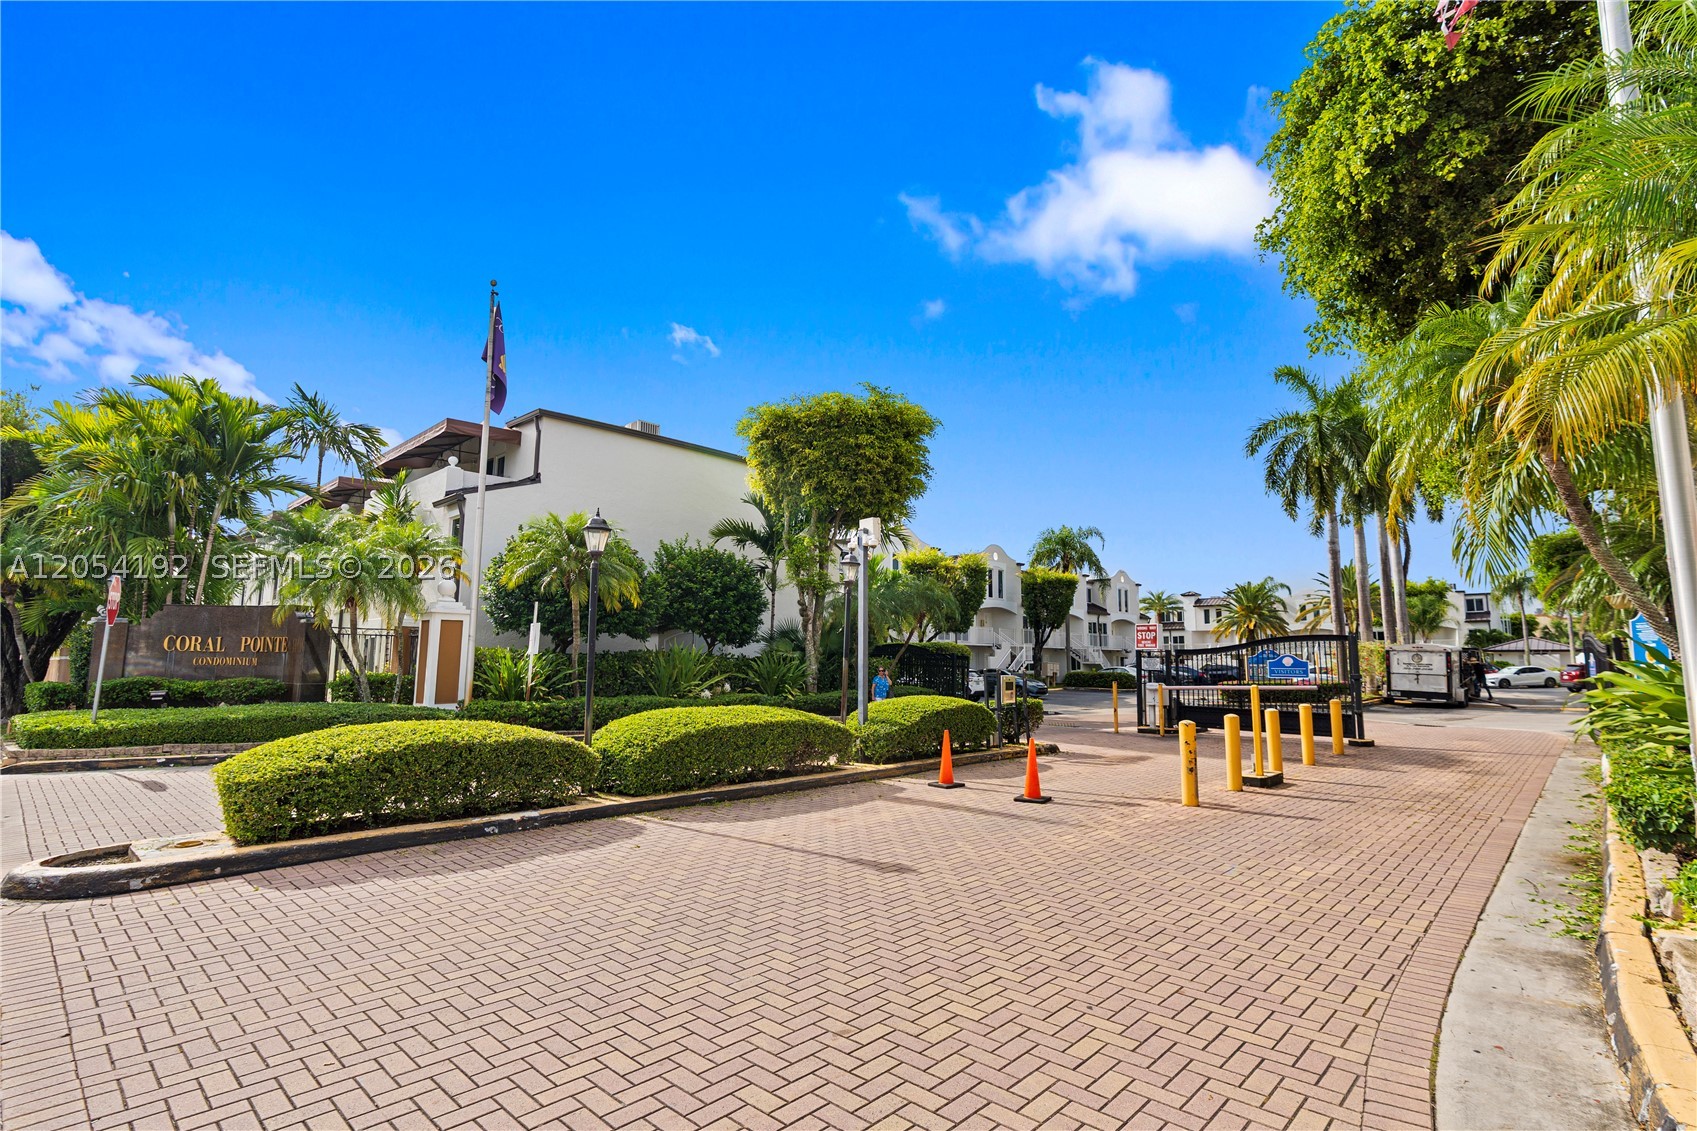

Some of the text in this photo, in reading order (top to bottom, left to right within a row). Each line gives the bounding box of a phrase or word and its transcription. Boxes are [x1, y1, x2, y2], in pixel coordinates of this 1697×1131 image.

[1137, 631, 1156, 640] STOP
[163, 634, 288, 653] CORAL POINTE
[192, 656, 258, 667] CONDOMINIUM
